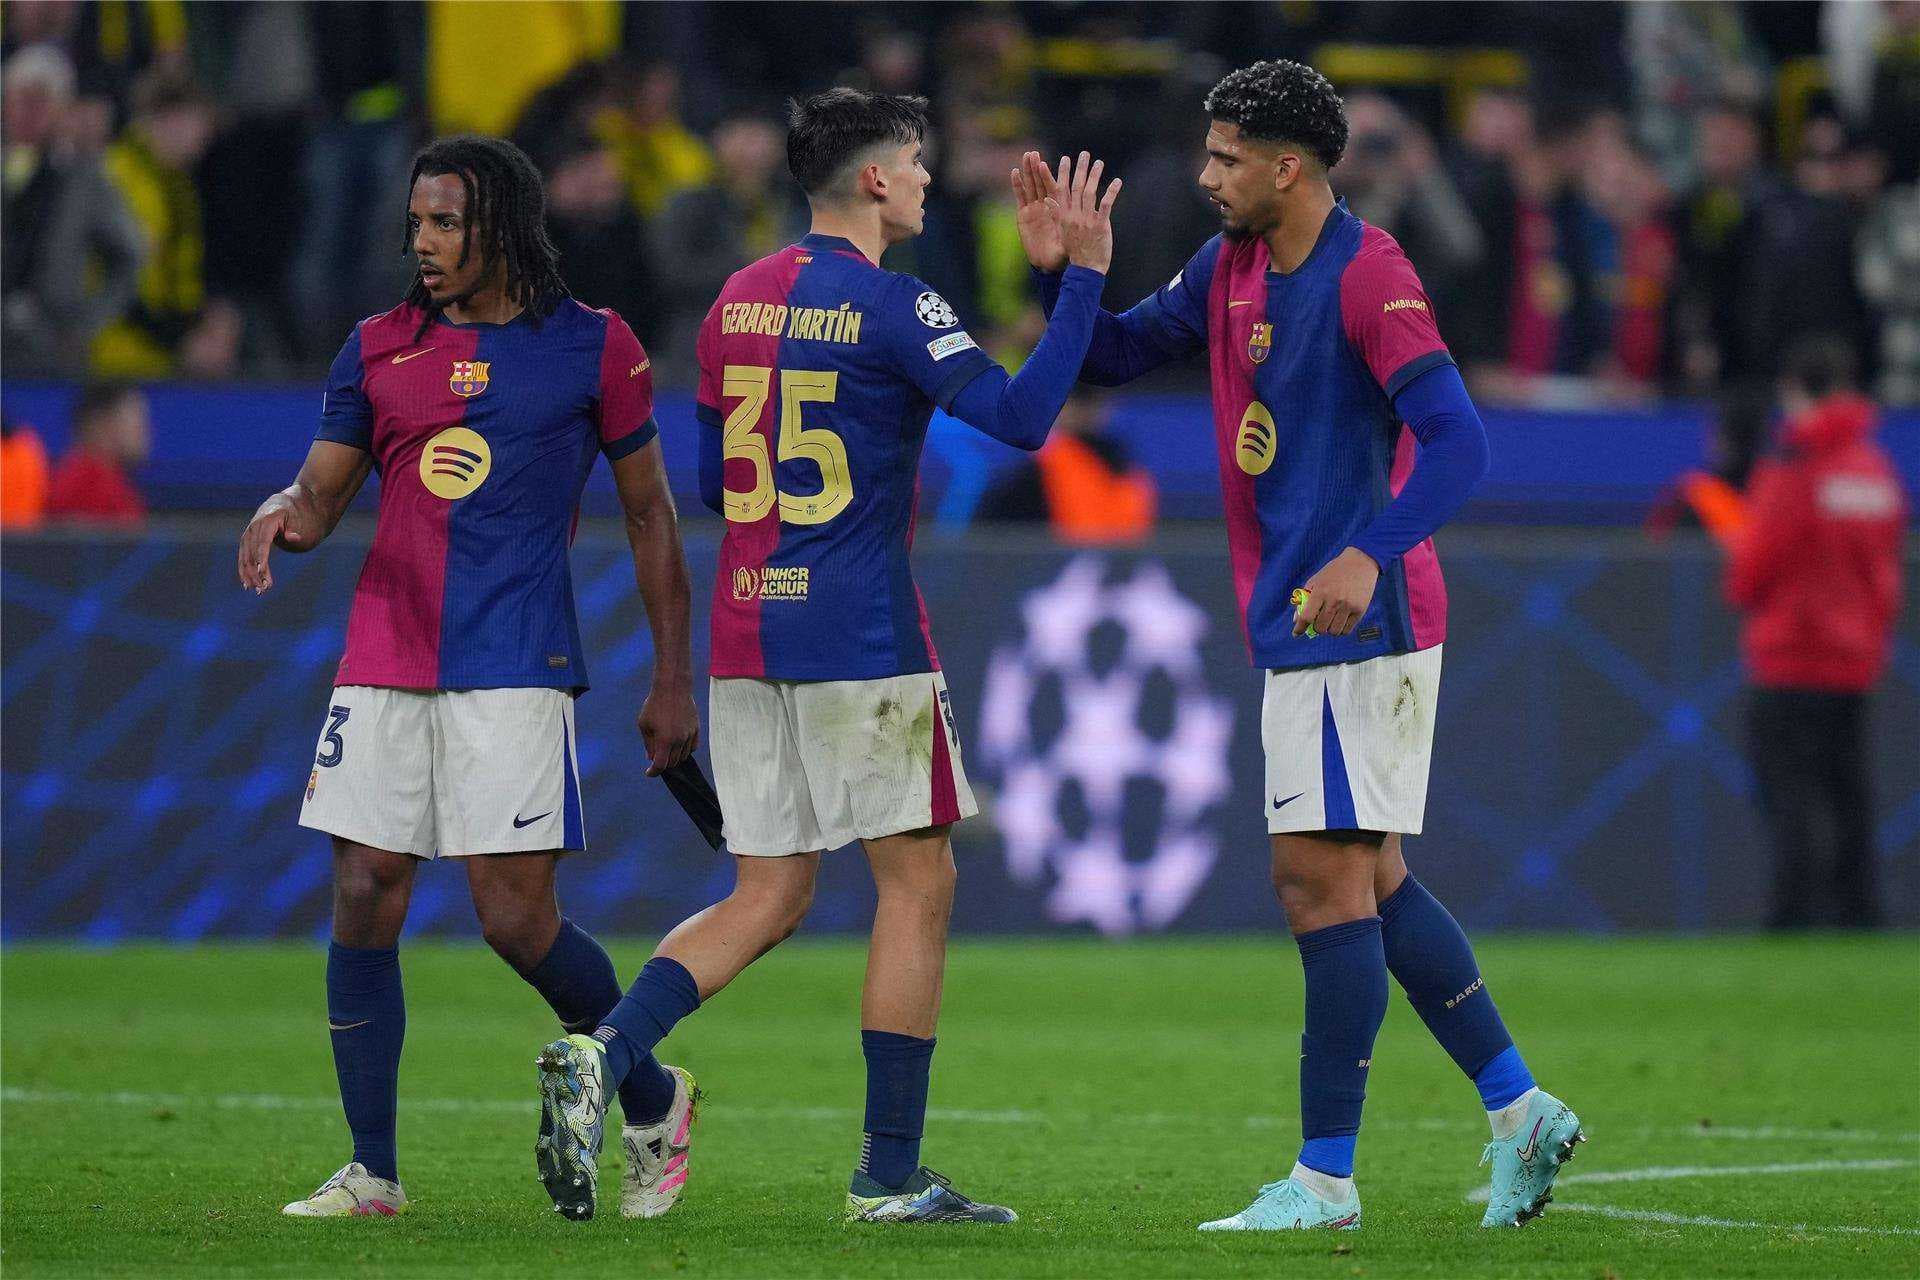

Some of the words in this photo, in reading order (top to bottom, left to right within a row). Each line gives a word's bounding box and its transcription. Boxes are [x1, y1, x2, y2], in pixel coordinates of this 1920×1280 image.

[721, 302, 788, 337] GERARD
[722, 364, 854, 526] 35
[758, 581, 809, 595] ACNUR
[760, 567, 809, 581] UNHCR
[316, 704, 351, 768] 3
